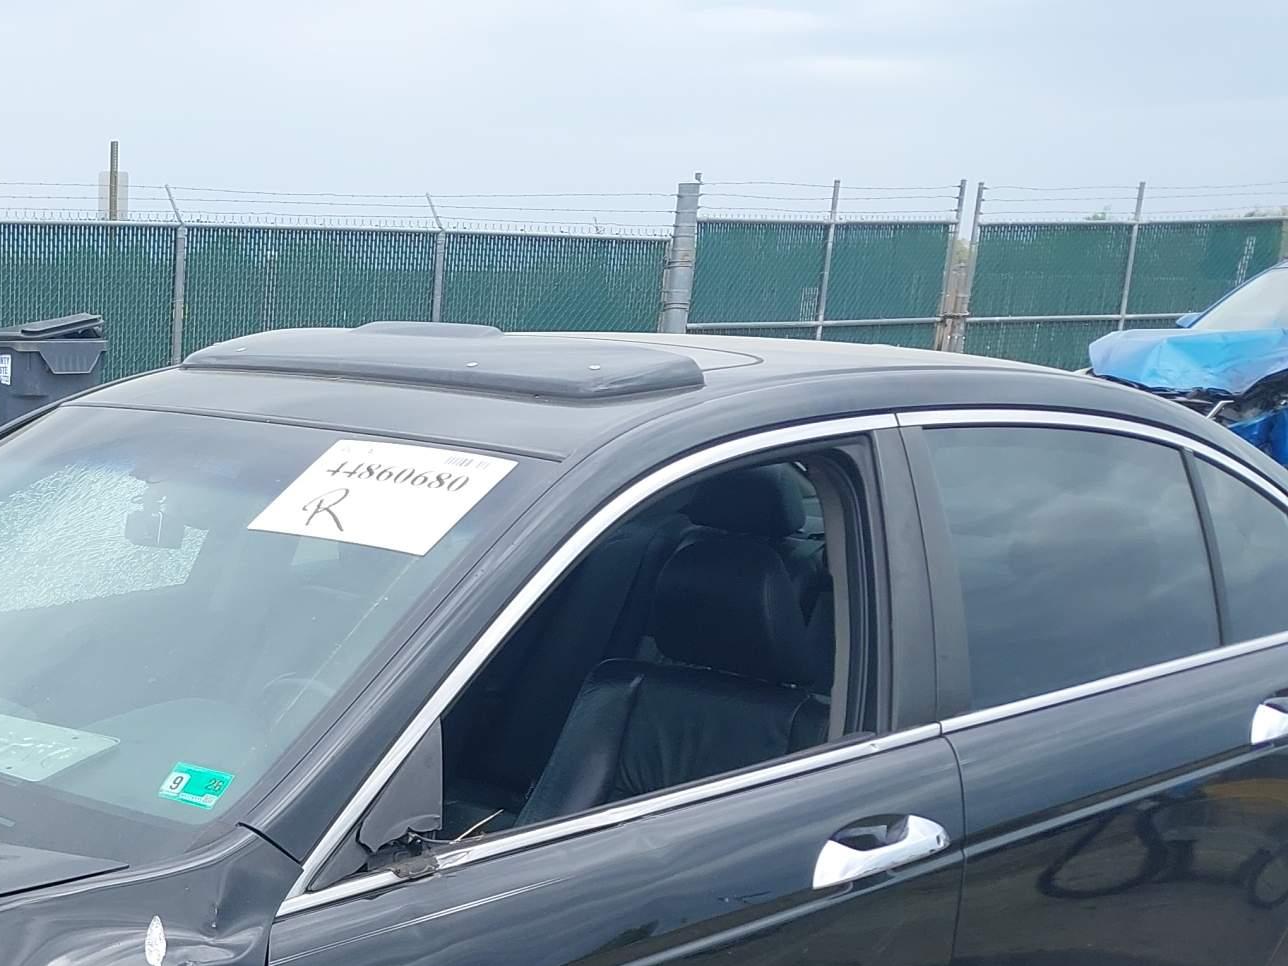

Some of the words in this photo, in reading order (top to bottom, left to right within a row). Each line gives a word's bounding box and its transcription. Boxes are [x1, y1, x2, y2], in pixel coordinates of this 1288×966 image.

[326, 460, 470, 493] 44860680
[301, 487, 350, 533] R
[169, 775, 184, 791] 9
